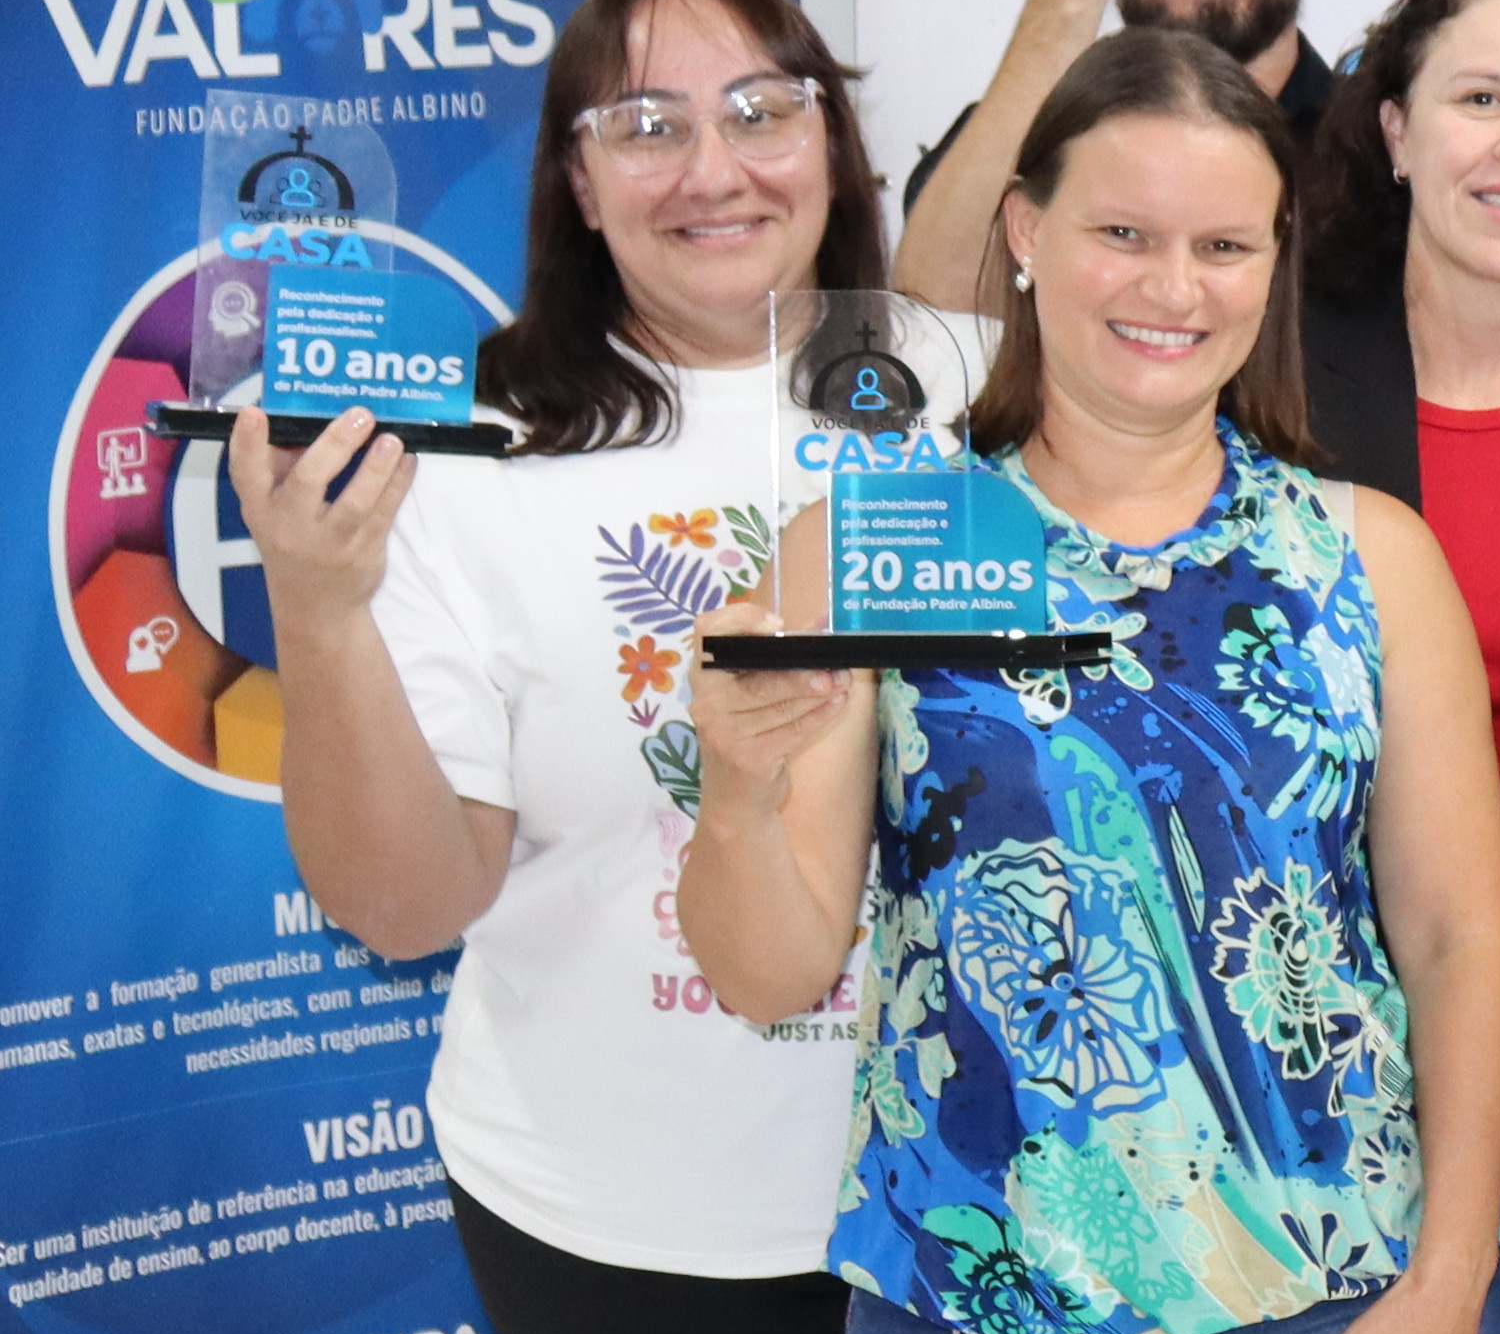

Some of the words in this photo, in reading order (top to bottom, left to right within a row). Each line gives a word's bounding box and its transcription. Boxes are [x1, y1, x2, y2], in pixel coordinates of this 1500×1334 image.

[136, 100, 289, 136] FUNDAÇÃO
[303, 97, 381, 127] PADRE
[392, 92, 485, 121] ALBINO
[220, 223, 372, 268] CASA
[277, 339, 336, 376] 10
[347, 349, 464, 386] anos
[795, 431, 948, 471] CASA
[841, 551, 901, 592] 20
[913, 558, 1034, 592] anos
[86, 990, 99, 1011] a
[111, 967, 199, 1007] formação
[210, 952, 322, 992] generalista
[335, 944, 369, 969] dos
[84, 1023, 146, 1053] exatas
[153, 1019, 166, 1040] e
[173, 997, 298, 1035] tecnológicas,
[307, 990, 352, 1013] com
[360, 977, 423, 1005] ensino
[763, 1023, 824, 1042] JUST
[829, 1022, 859, 1041] AS
[186, 1032, 316, 1074] necessidades
[321, 1017, 411, 1053] regionais
[415, 1017, 428, 1038] e
[303, 1098, 424, 1163] VISÃO
[34, 1233, 76, 1260] uma
[82, 1206, 183, 1249] instituição
[188, 1199, 212, 1225] de
[217, 1180, 317, 1219] referência
[323, 1178, 349, 1200] na
[354, 1158, 447, 1195] educação
[8, 1262, 103, 1308] qualidade
[108, 1256, 133, 1282] de
[137, 1245, 204, 1276] ensino,
[209, 1238, 231, 1260] ao
[235, 1225, 290, 1253] corpo
[295, 1210, 380, 1242] docente,
[385, 1202, 398, 1227] à
